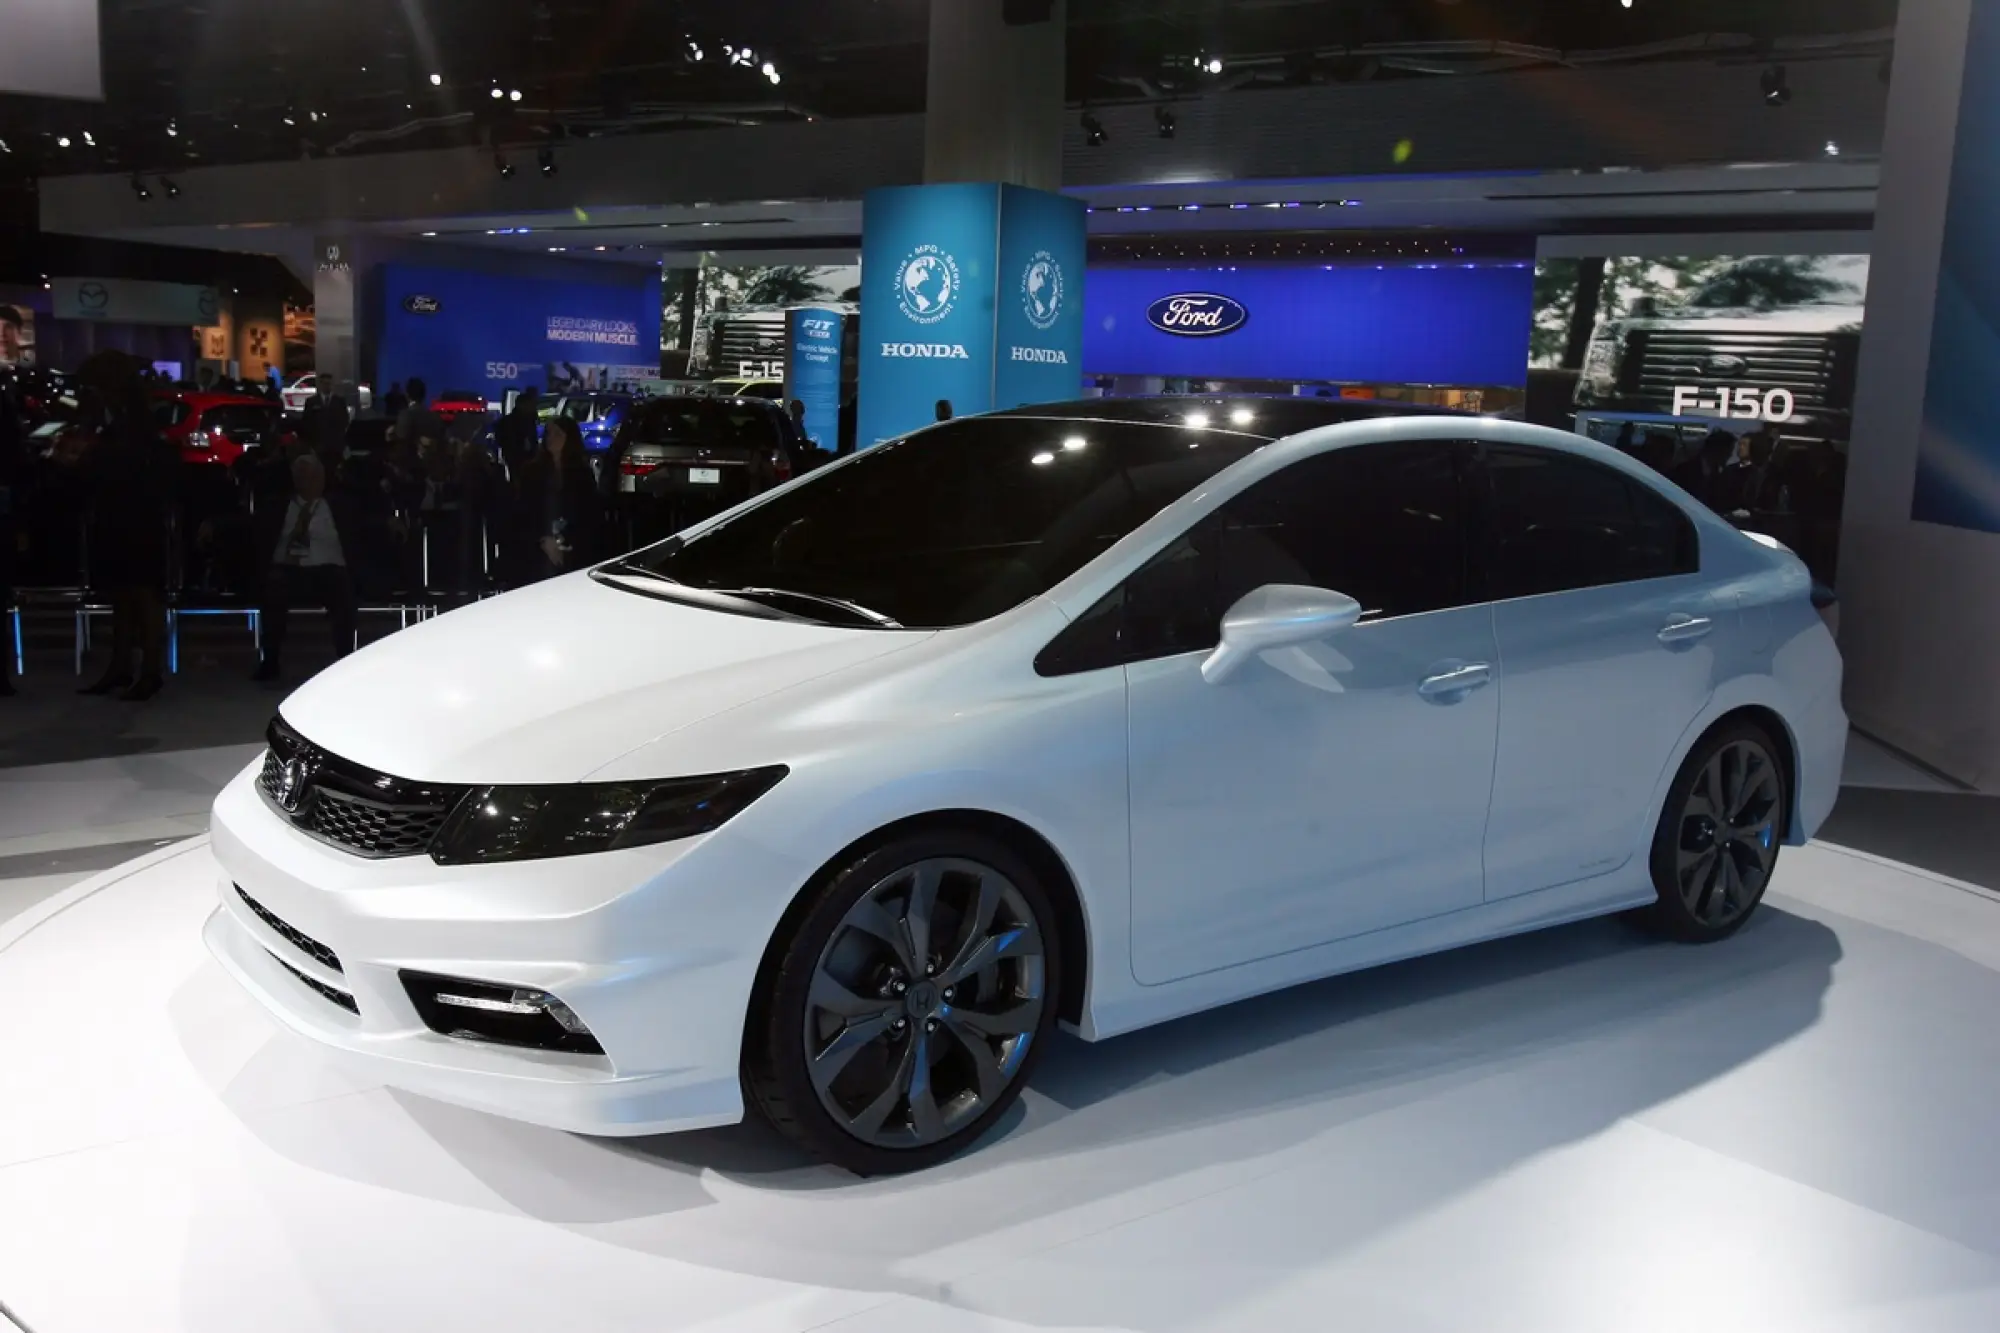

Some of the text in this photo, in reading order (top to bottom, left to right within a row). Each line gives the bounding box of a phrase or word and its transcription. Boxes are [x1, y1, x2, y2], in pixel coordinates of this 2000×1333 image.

[915, 245, 938, 254] MPG
[893, 260, 908, 290] Value
[946, 254, 961, 291] Safety
[900, 301, 954, 324] Environment
[1162, 298, 1224, 326] Ford
[801, 319, 835, 331] FIT
[548, 330, 594, 343] MODERN
[880, 342, 969, 359] HONDA
[1011, 346, 1068, 364] HONDA
[486, 361, 518, 379] 550
[740, 361, 784, 380] F-15
[1672, 385, 1794, 422] F-150
